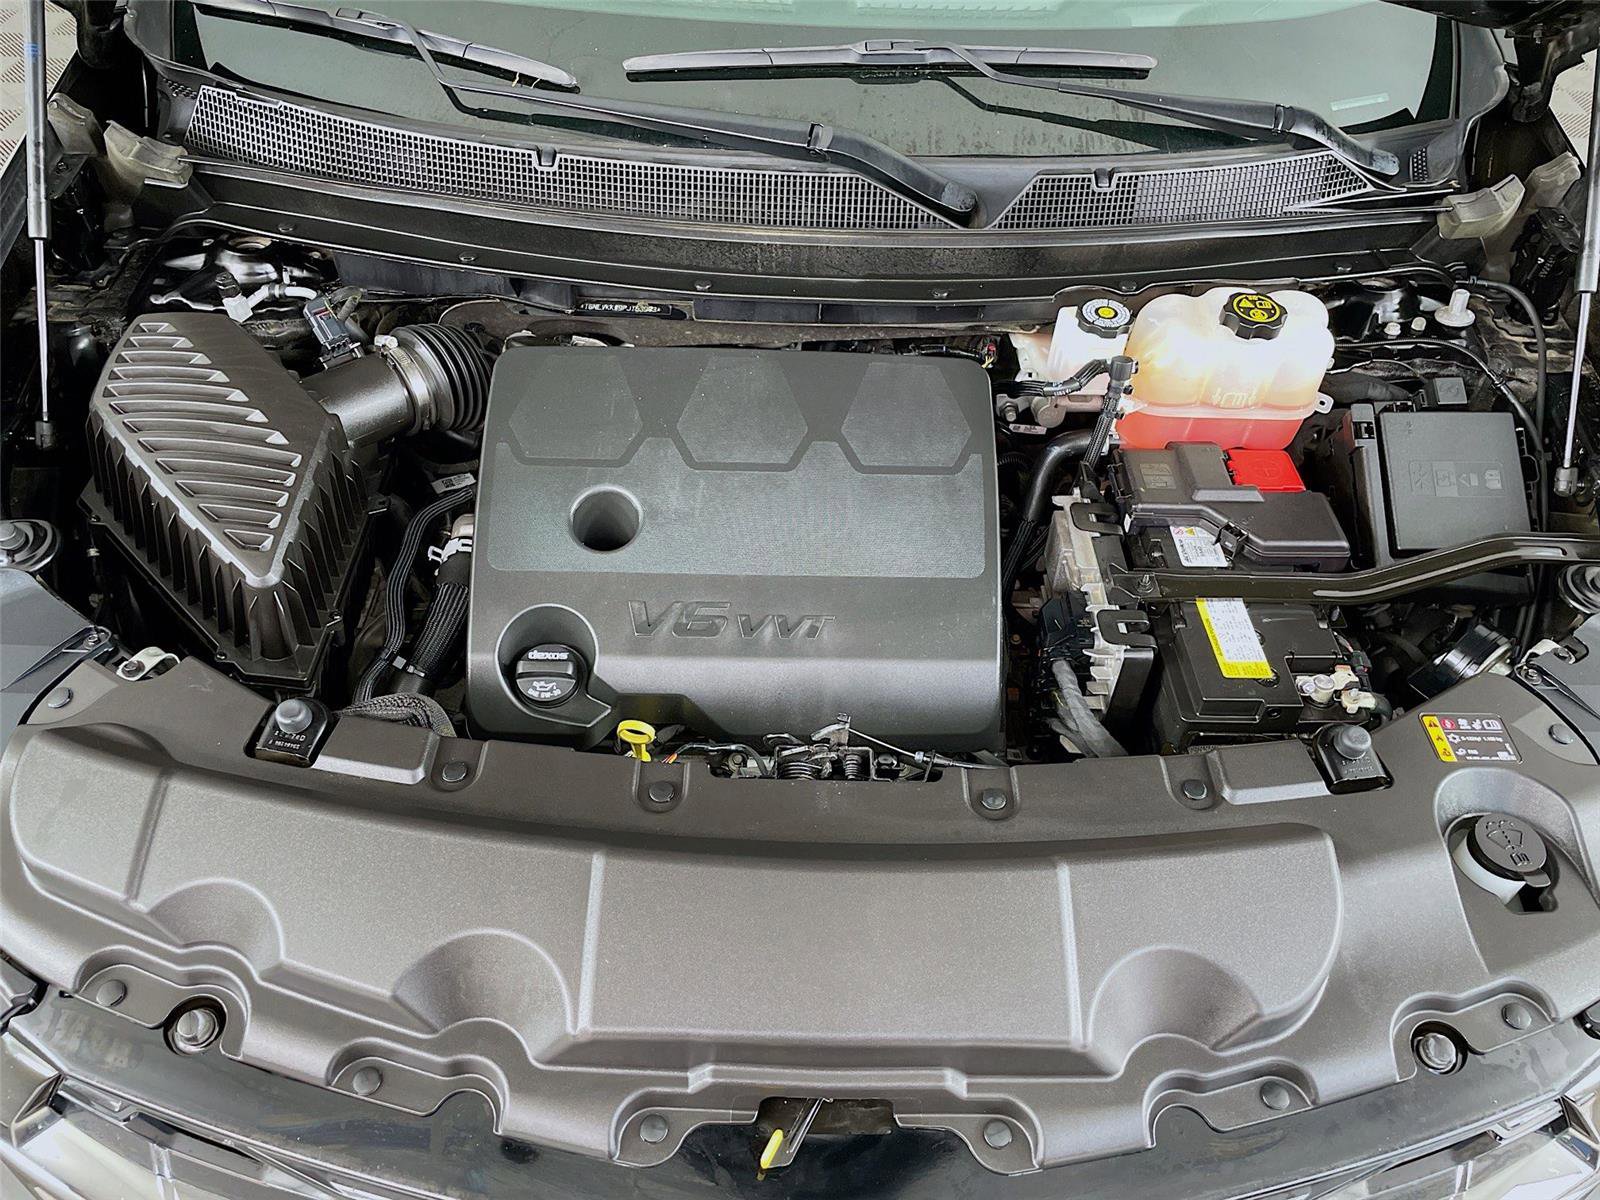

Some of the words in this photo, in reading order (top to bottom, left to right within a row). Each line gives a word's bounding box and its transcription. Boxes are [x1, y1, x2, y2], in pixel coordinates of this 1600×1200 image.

[628, 600, 731, 639] V6
[737, 614, 836, 640] VVT
[528, 650, 569, 660] dexos
